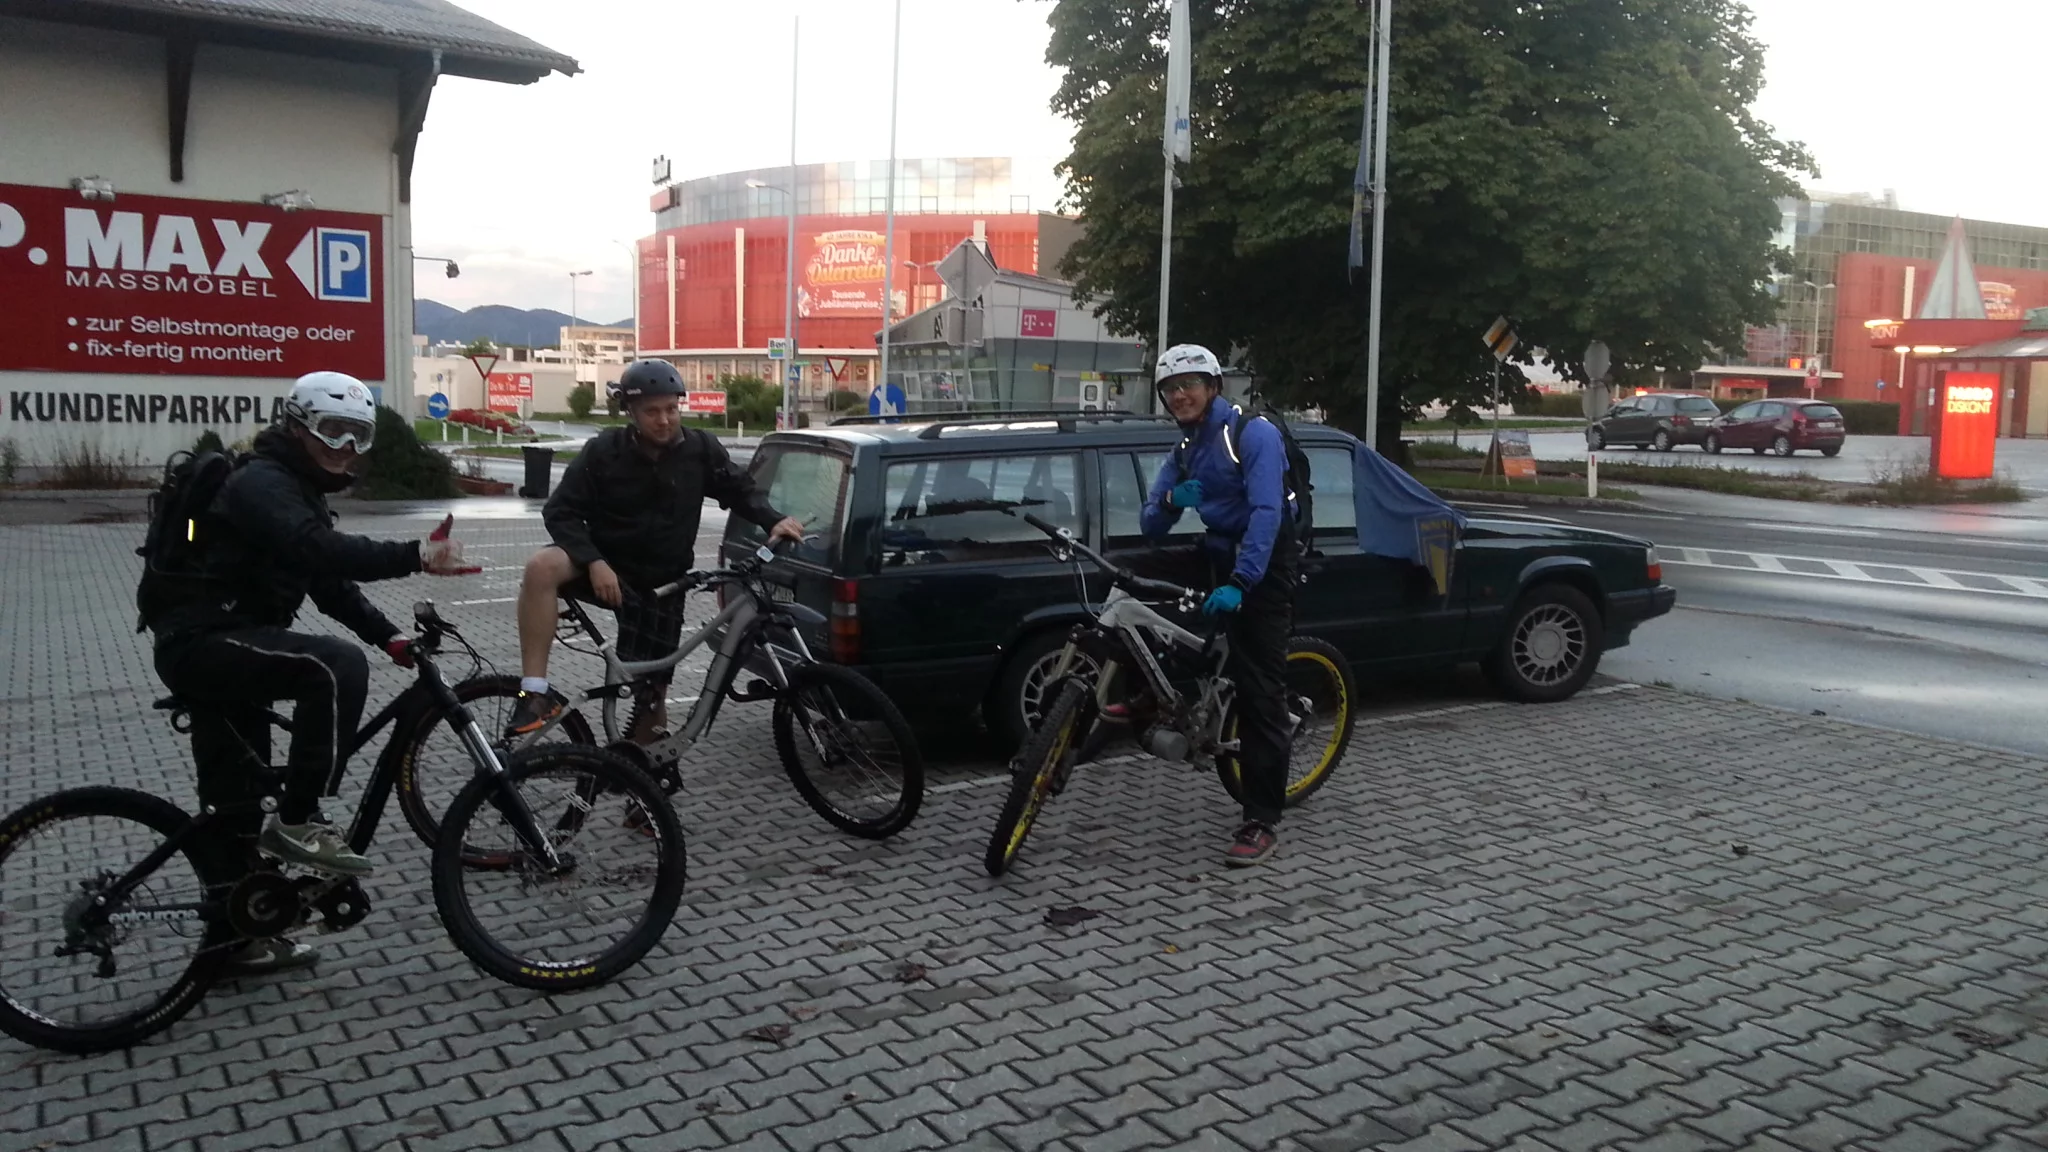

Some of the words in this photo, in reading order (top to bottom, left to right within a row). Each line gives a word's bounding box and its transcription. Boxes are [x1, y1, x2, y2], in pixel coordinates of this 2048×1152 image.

[328, 240, 361, 290] P
[822, 242, 876, 265] Danke
[66, 270, 278, 298] MASSMÖBEL
[85, 317, 125, 332] zur
[131, 316, 299, 343] Selbstmontage
[306, 323, 355, 342] oder
[86, 340, 183, 363] fix-fertig
[191, 346, 283, 362] montiert
[10, 391, 285, 424] KUNDENPARKPLA
[1947, 401, 1992, 413] DISKONT
[108, 908, 199, 926] entourage
[520, 965, 597, 979] MAXXIS
